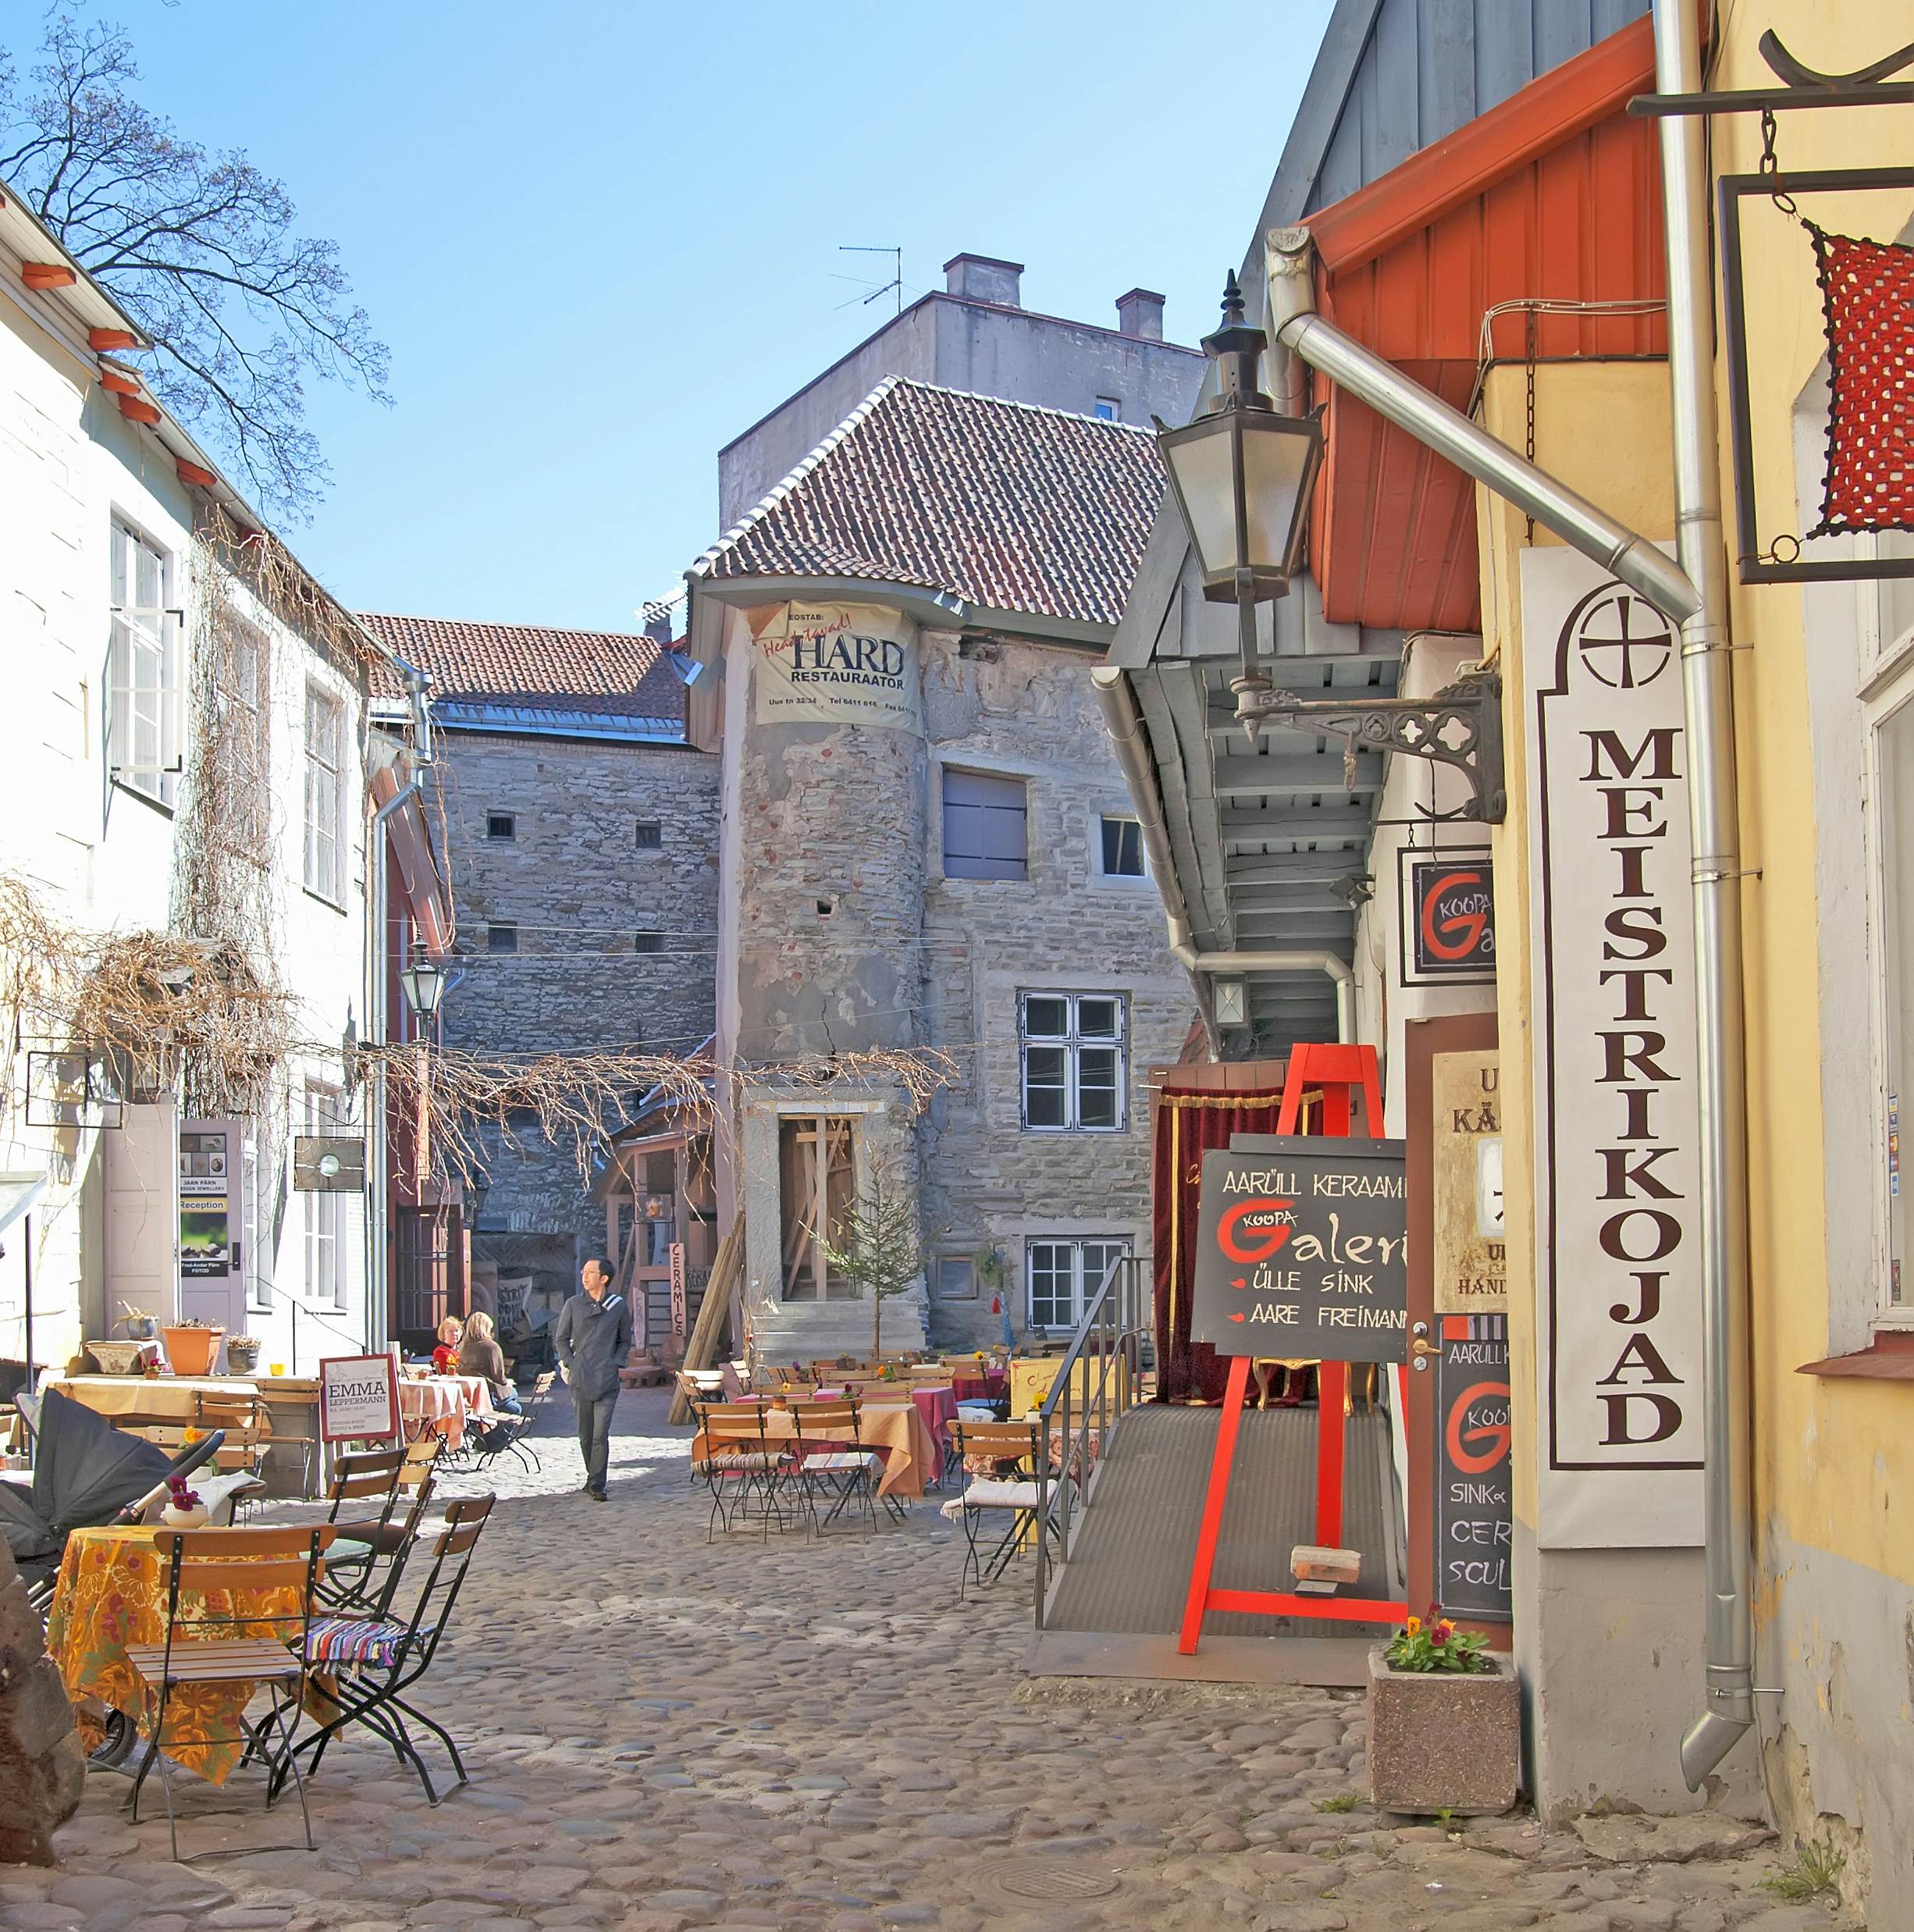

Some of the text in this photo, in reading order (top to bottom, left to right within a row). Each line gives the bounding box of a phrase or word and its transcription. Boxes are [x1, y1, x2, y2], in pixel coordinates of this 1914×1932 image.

[791, 634, 905, 676] HARD
[791, 671, 904, 690] RESTAURAATOR
[1439, 893, 1494, 919] KOOPA
[1579, 726, 1685, 1446] MEISTRIKOJAD
[1453, 1101, 1501, 1133] KÄ
[1222, 1169, 1302, 1196] AARÜLL
[180, 1201, 224, 1210] Reception
[1242, 1210, 1300, 1228] KOOPA
[1252, 1263, 1301, 1291] ÜLLE
[672, 1244, 683, 1337] CERAMICS
[1249, 1303, 1300, 1325] AARE
[1448, 1342, 1503, 1364] AARÜLL
[329, 1381, 386, 1398] EMMA
[329, 1395, 386, 1406] LEPPERMANN
